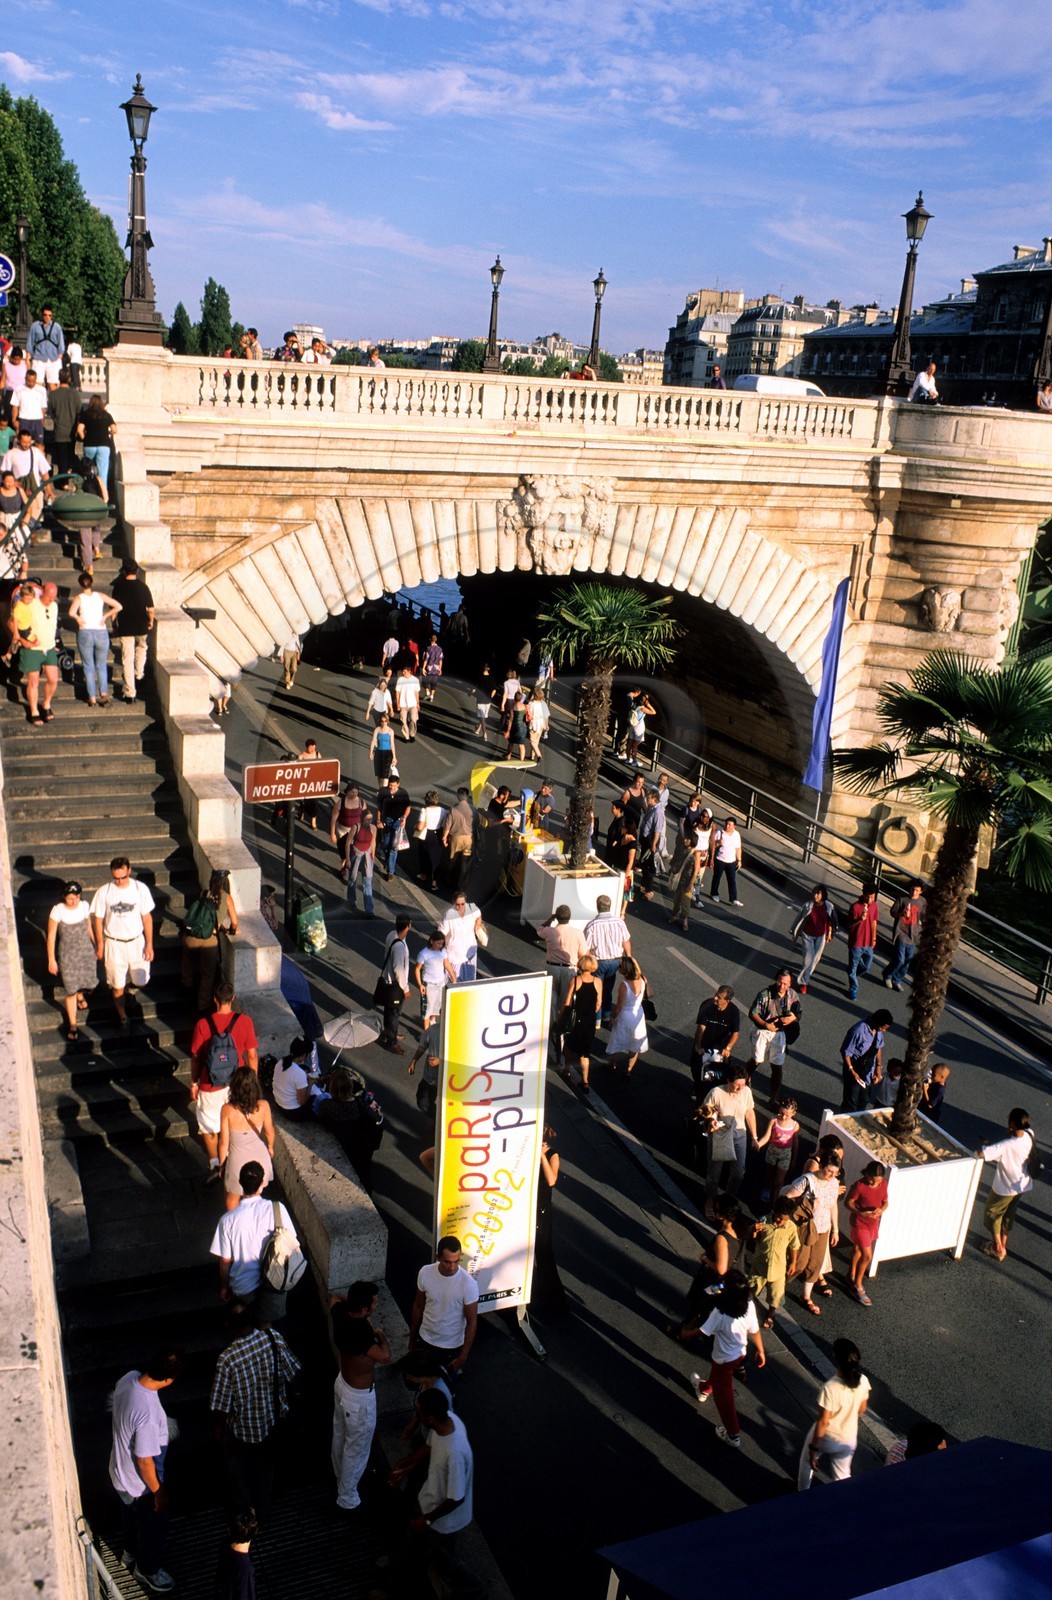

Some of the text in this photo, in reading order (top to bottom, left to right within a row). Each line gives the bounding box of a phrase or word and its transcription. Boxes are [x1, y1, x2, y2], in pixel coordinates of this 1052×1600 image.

[275, 767, 311, 780] PONT
[252, 781, 333, 797] NOTRE DAME
[462, 1168, 525, 1257] 2002
[488, 1198, 499, 1215] 2002
[487, 1290, 508, 1300] PARIS
